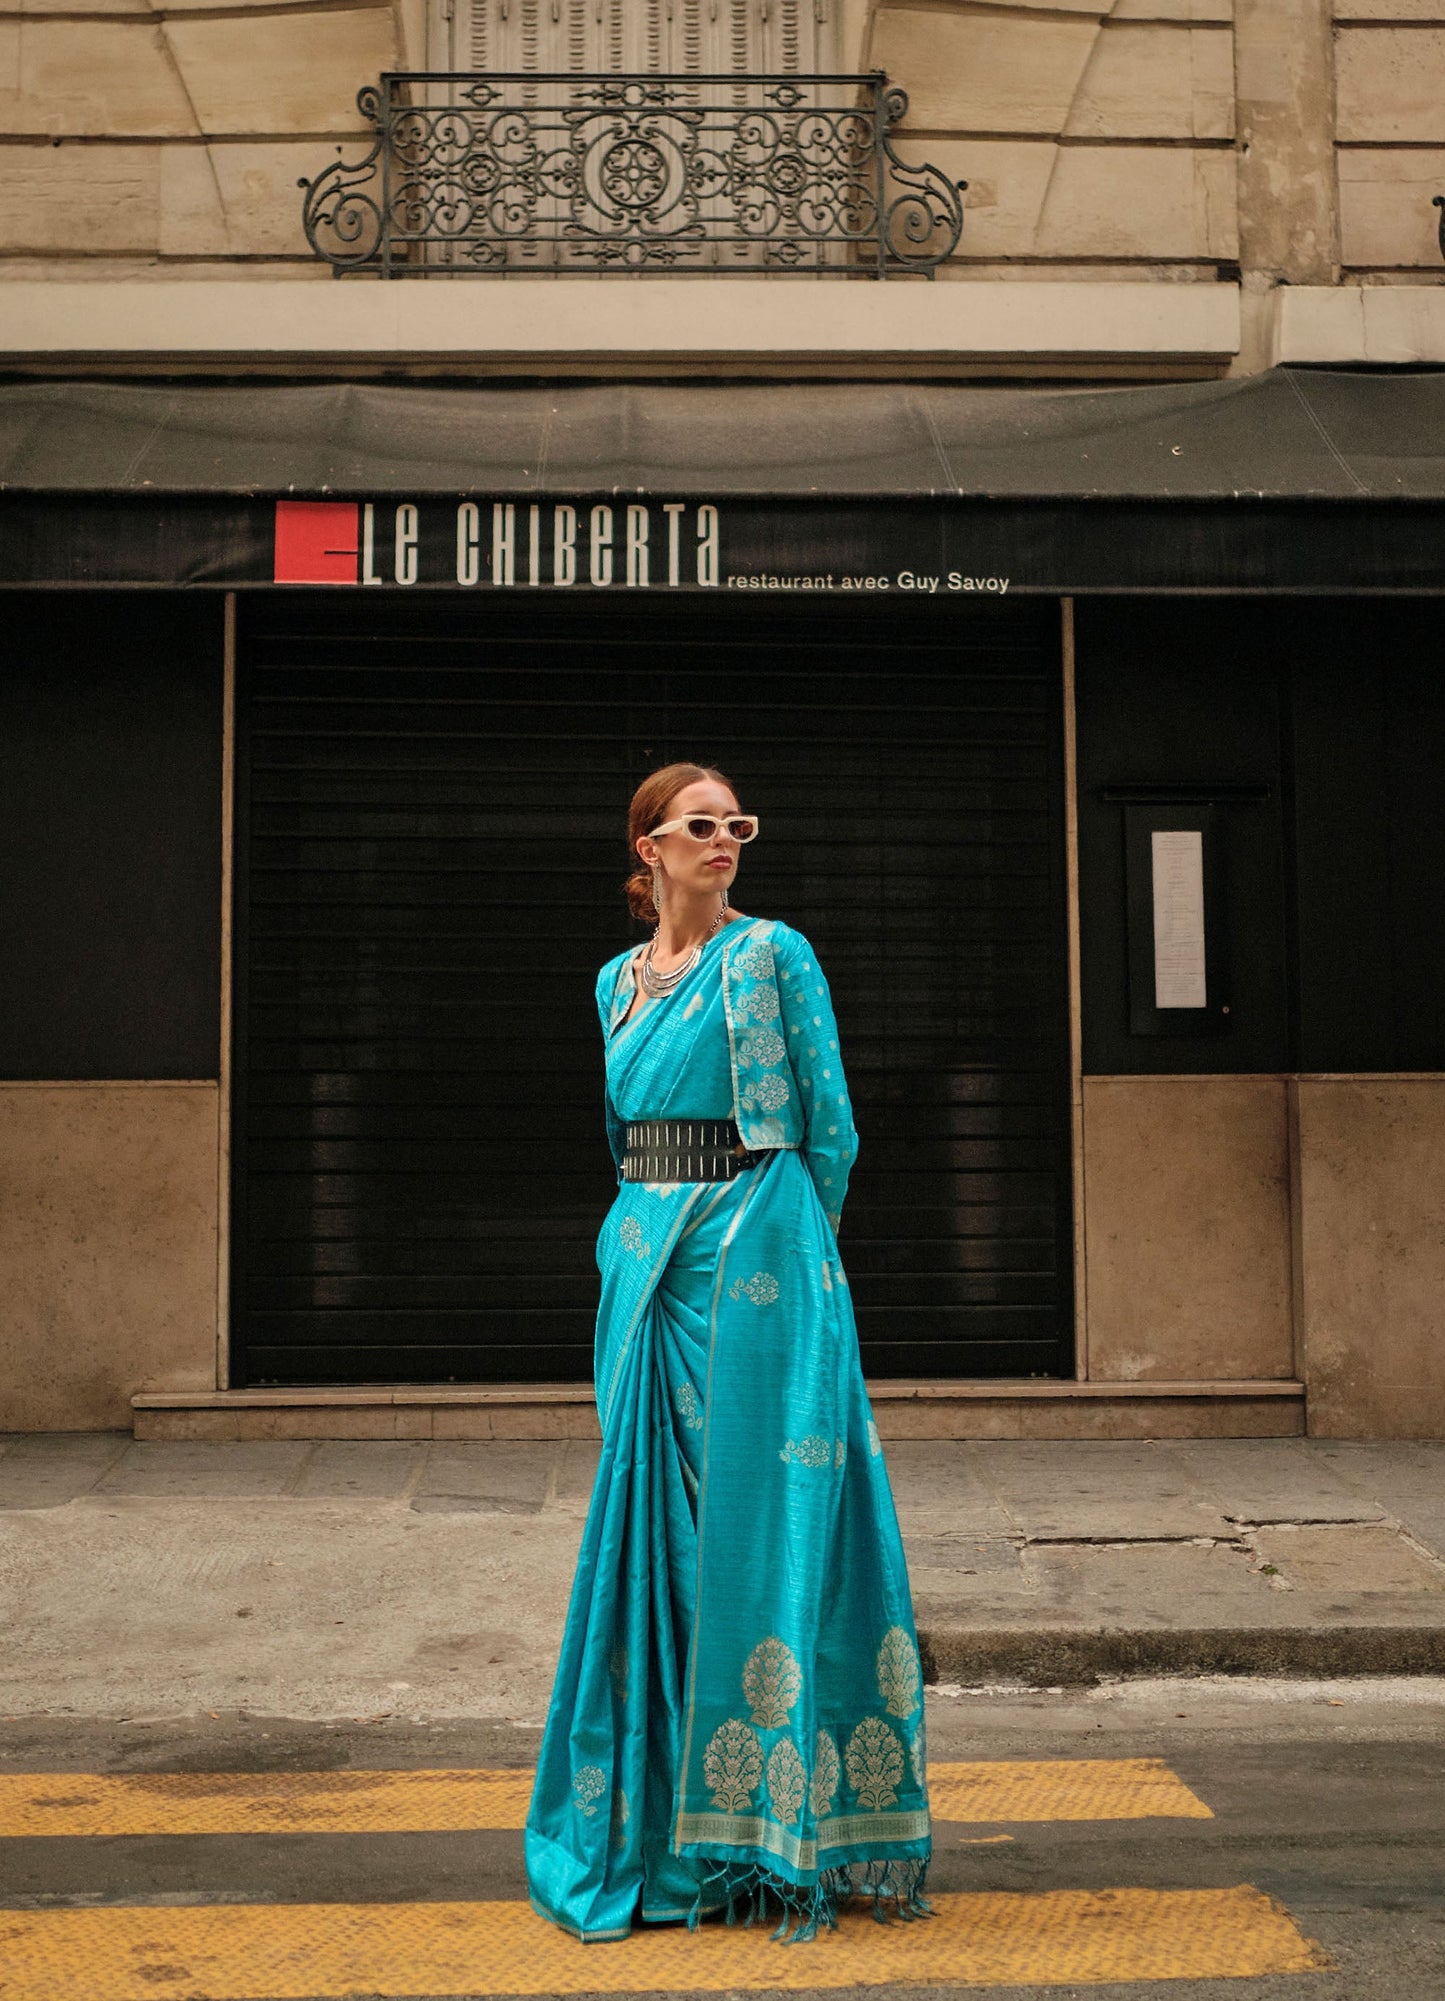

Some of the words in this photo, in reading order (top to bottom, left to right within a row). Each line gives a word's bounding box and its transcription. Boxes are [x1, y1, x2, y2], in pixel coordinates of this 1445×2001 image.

[727, 573, 834, 590] restaurant
[841, 575, 890, 590] avec
[897, 571, 940, 594] Guy
[947, 572, 1010, 595] Savoy
